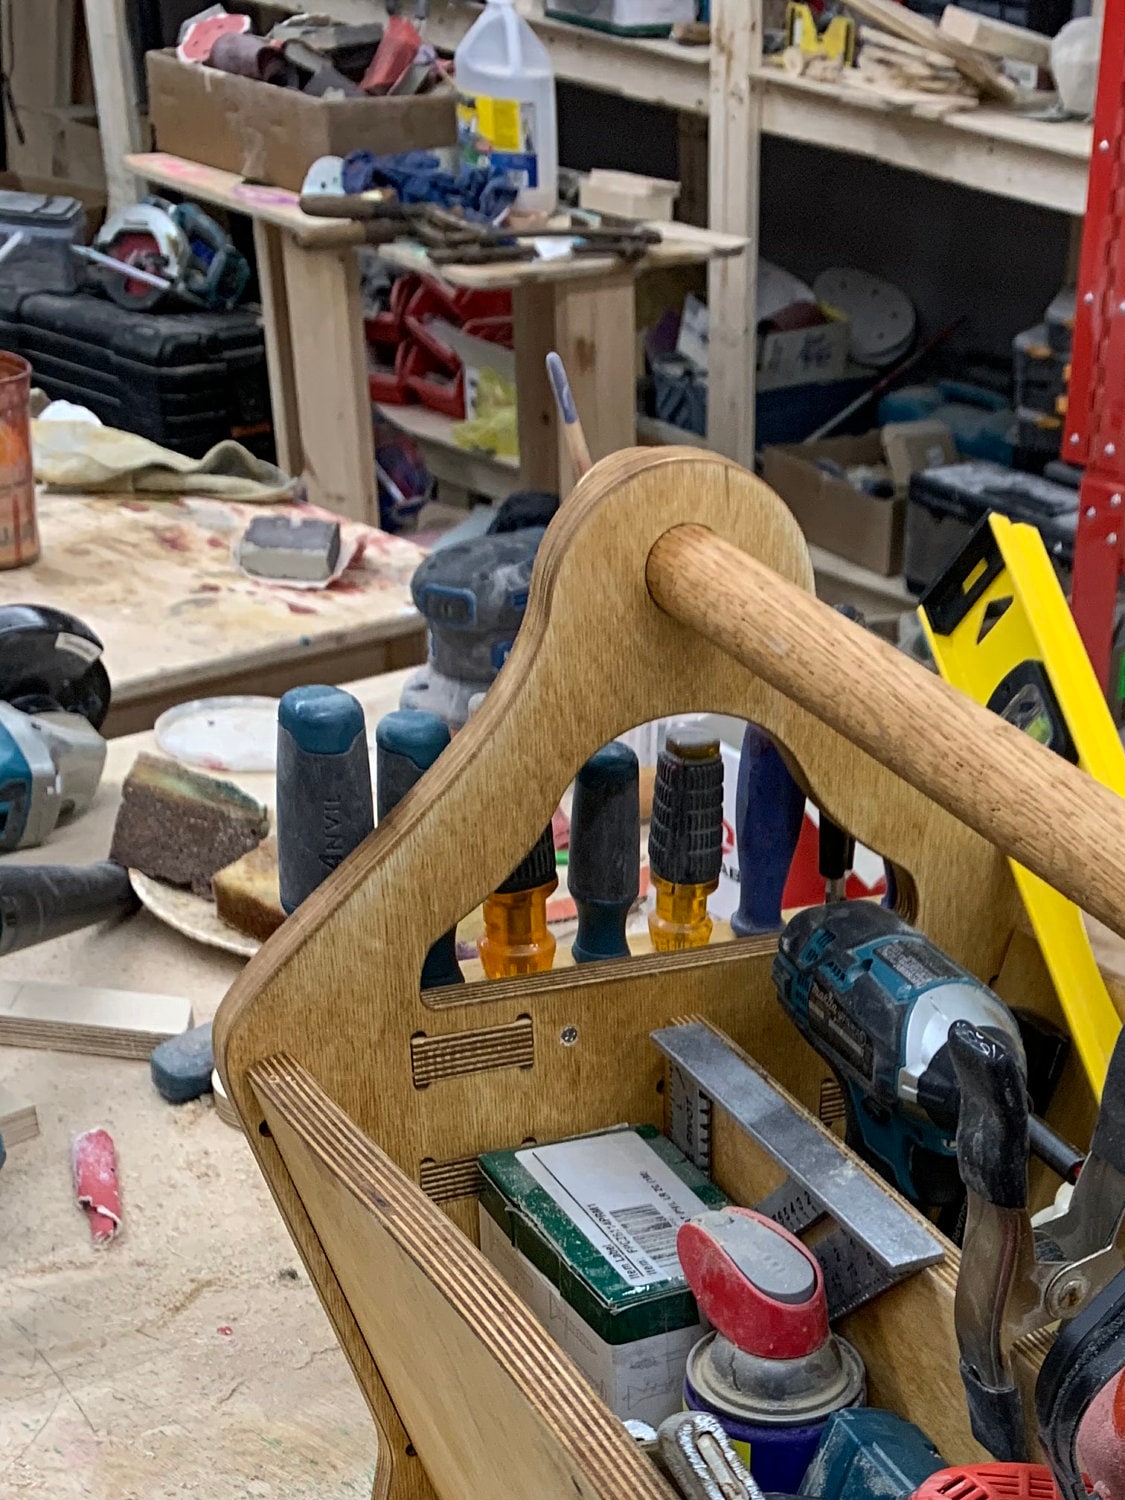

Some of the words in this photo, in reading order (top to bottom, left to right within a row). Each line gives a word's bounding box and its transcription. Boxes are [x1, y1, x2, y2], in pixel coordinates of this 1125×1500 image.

[319, 795, 342, 870] ANVIL
[602, 1244, 625, 1263] Label
[621, 1263, 641, 1280] Item
